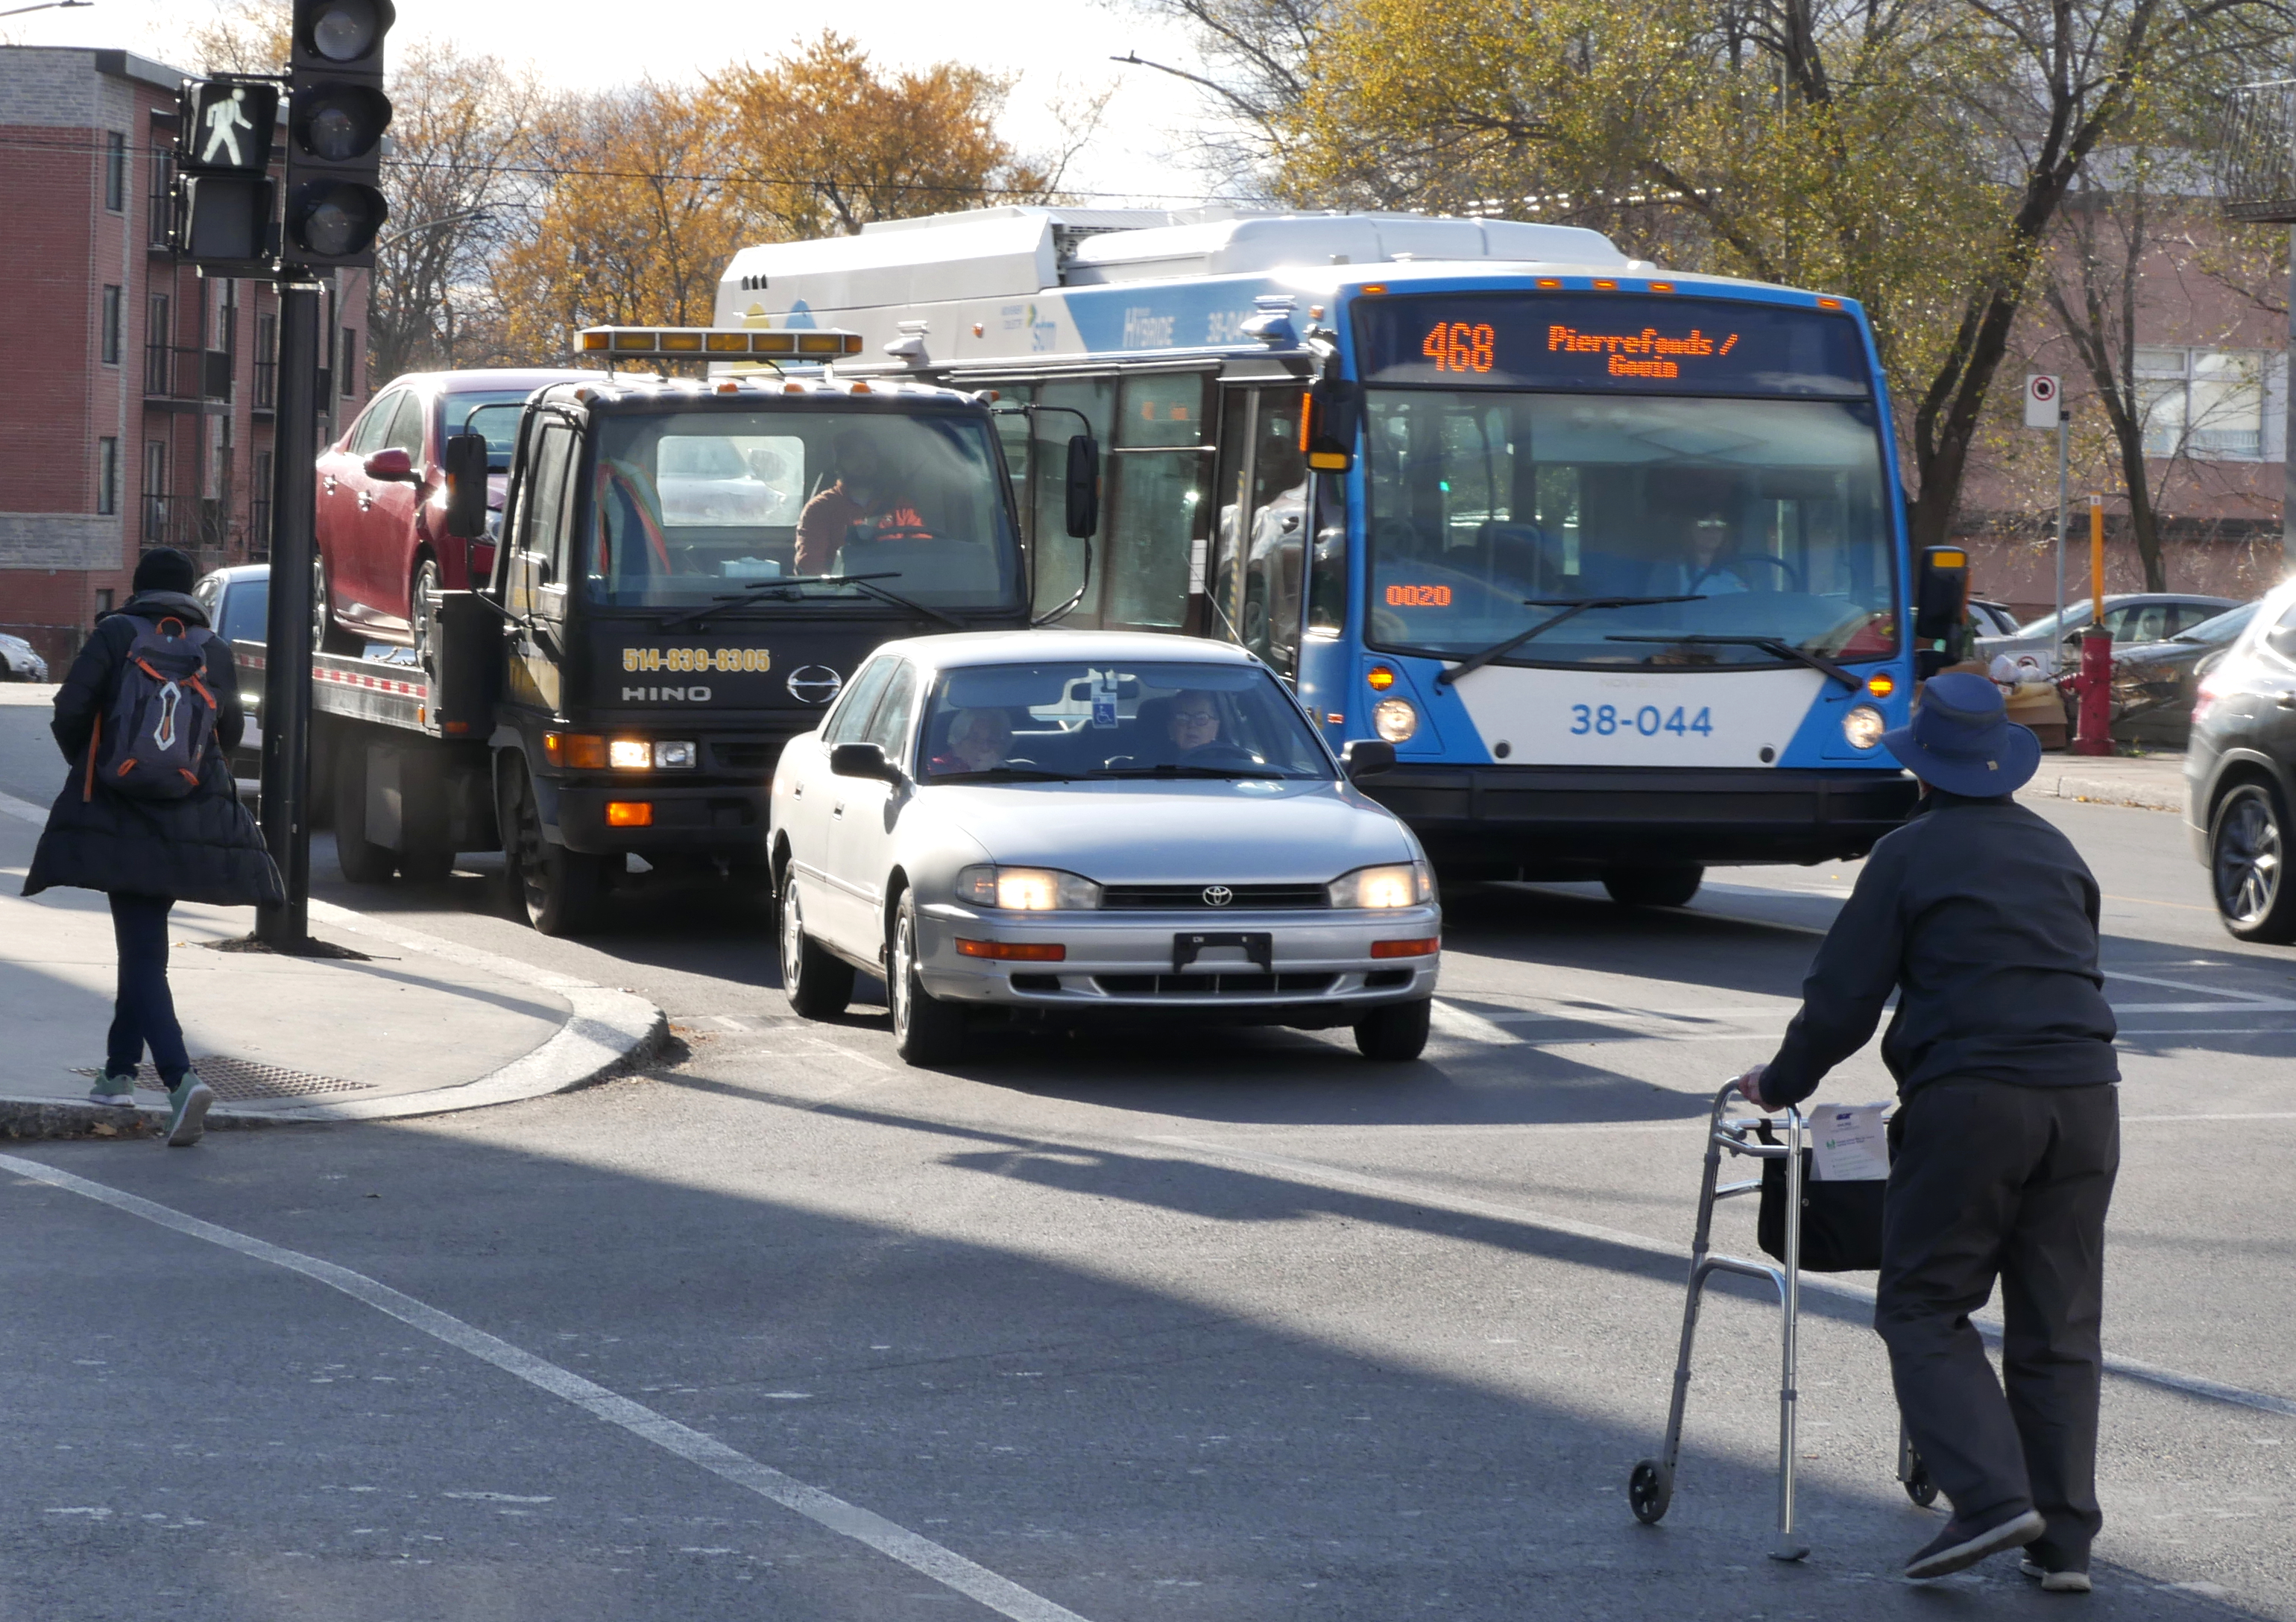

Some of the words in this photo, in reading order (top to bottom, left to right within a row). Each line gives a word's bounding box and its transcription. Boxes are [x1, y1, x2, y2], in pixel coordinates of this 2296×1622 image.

[1422, 322, 1495, 372] 468
[1548, 325, 1713, 356] Pierrefonds
[1608, 354, 1678, 378] Gouin
[1387, 585, 1451, 606] 0020
[622, 648, 771, 672] 514-839-8305
[622, 686, 712, 701] HINO
[1570, 703, 1713, 736] 38-044
